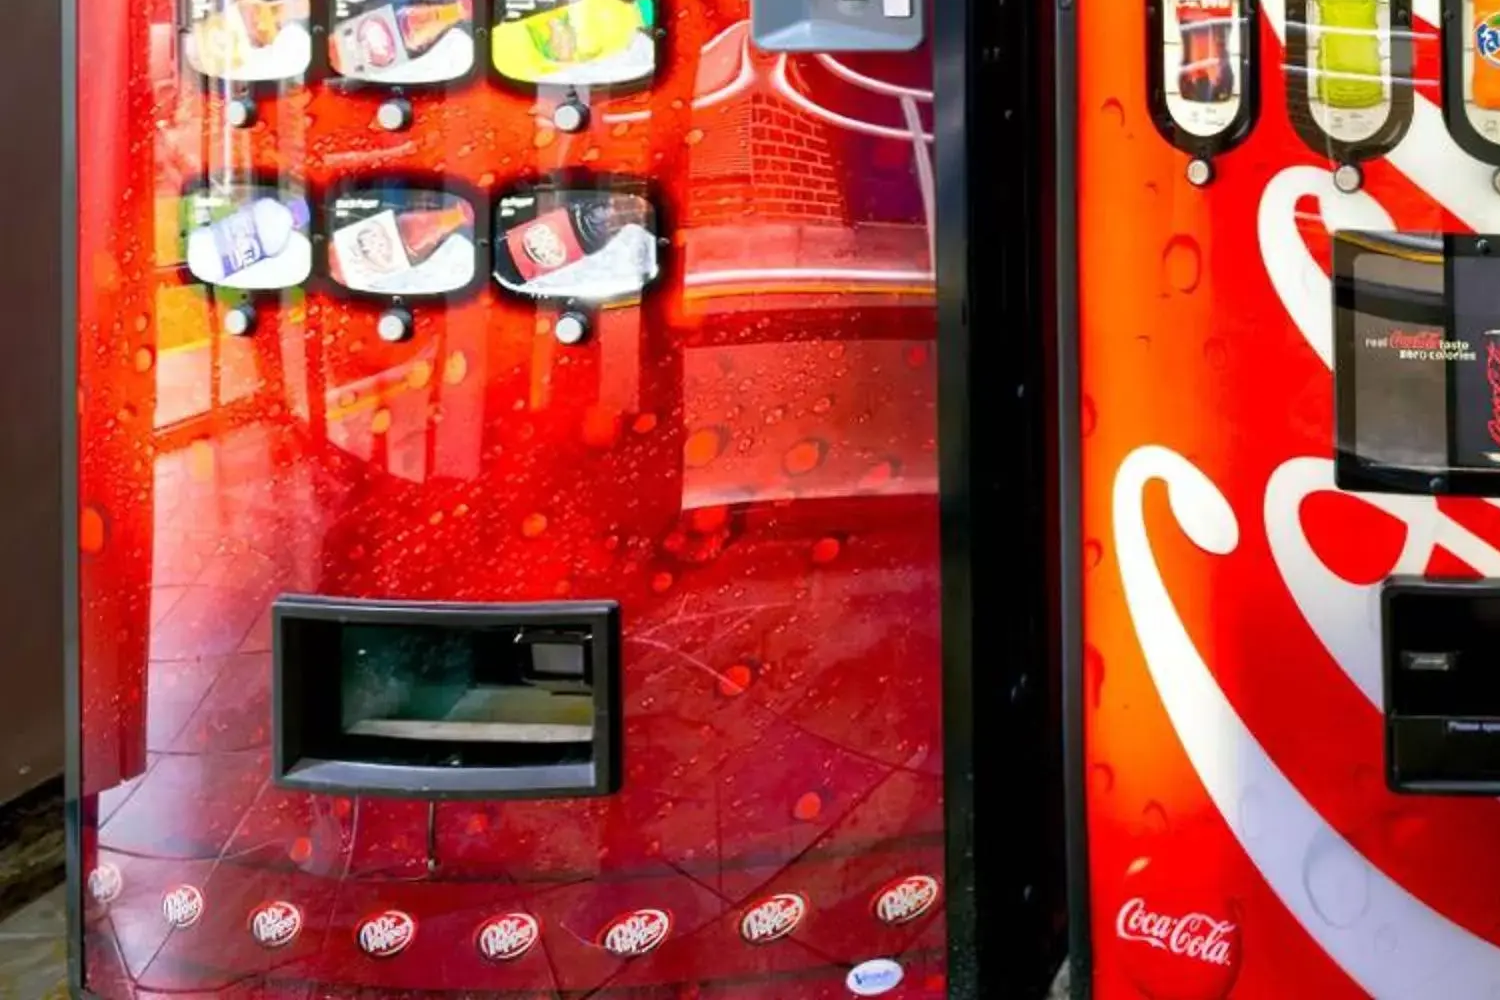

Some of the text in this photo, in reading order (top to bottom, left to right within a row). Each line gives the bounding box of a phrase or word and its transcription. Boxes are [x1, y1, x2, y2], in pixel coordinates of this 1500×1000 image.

[1400, 349, 1476, 361] zero calories
[1116, 898, 1235, 966] Coca-Cola
